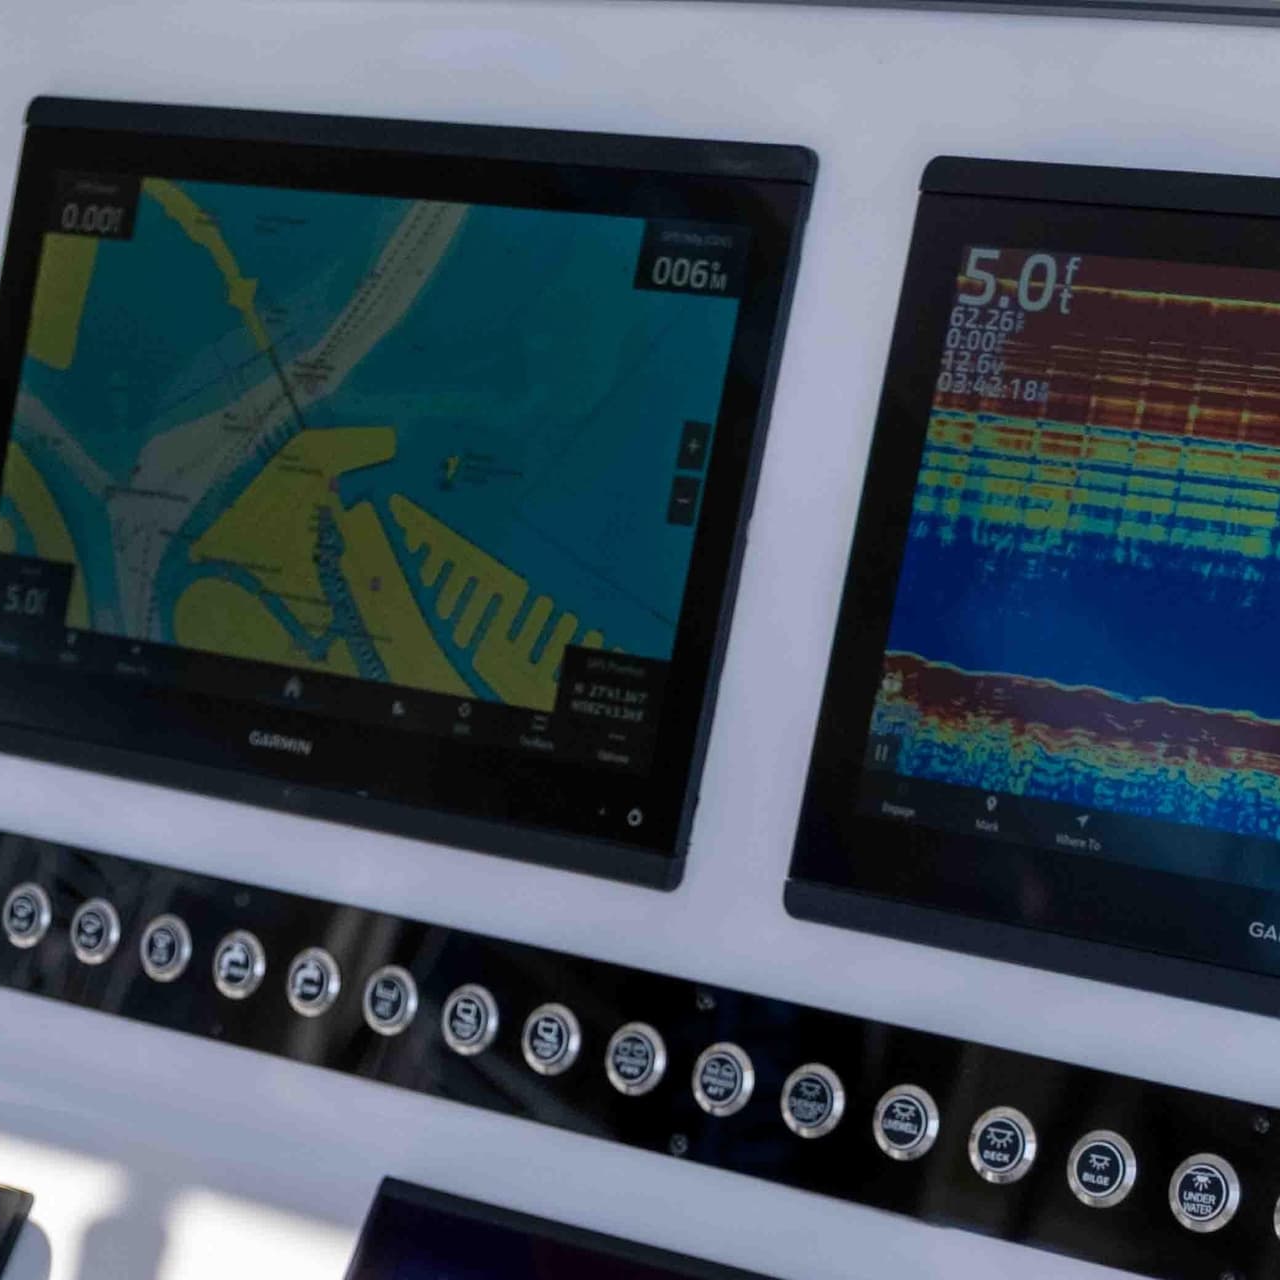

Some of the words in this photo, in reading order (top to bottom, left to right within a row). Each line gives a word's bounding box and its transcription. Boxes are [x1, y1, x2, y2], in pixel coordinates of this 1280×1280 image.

[652, 255, 709, 289] 006
[958, 247, 1057, 312] 5.0
[248, 729, 313, 756] GARMIN
[983, 1150, 1010, 1163] DECK
[1081, 1172, 1110, 1186] BILGE
[1182, 1191, 1216, 1206] UNDER
[1182, 1201, 1213, 1215] WATER
